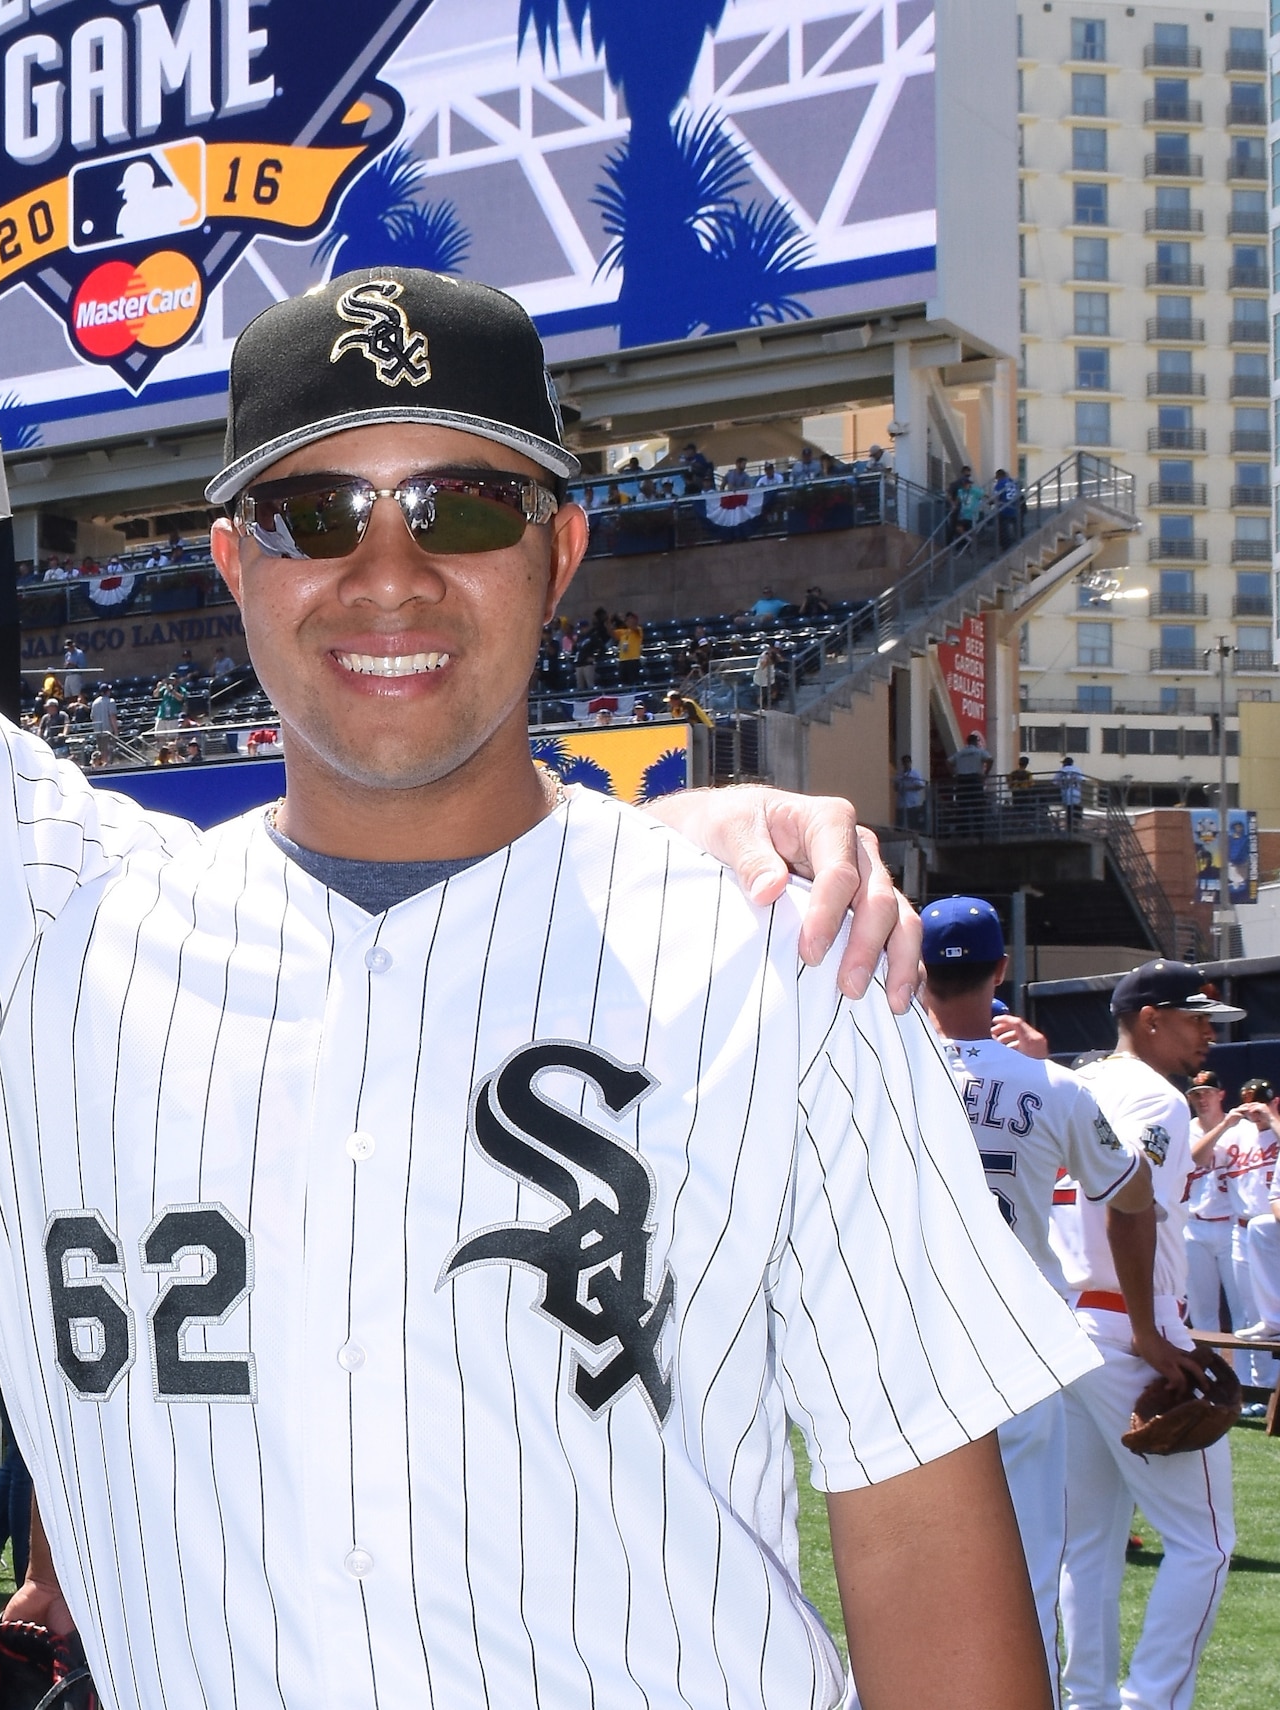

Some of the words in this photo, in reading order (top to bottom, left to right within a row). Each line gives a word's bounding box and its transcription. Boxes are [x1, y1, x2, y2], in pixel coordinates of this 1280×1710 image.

[5, 0, 276, 166] GAME
[76, 280, 198, 330] MasterCard
[970, 617, 984, 639] THE
[21, 629, 125, 661] JALSCO
[965, 636, 984, 660] BEER
[954, 653, 984, 680] GARDEN
[953, 673, 985, 701] BALLAST
[962, 698, 984, 721] POINT
[42, 1201, 259, 1404] 62
